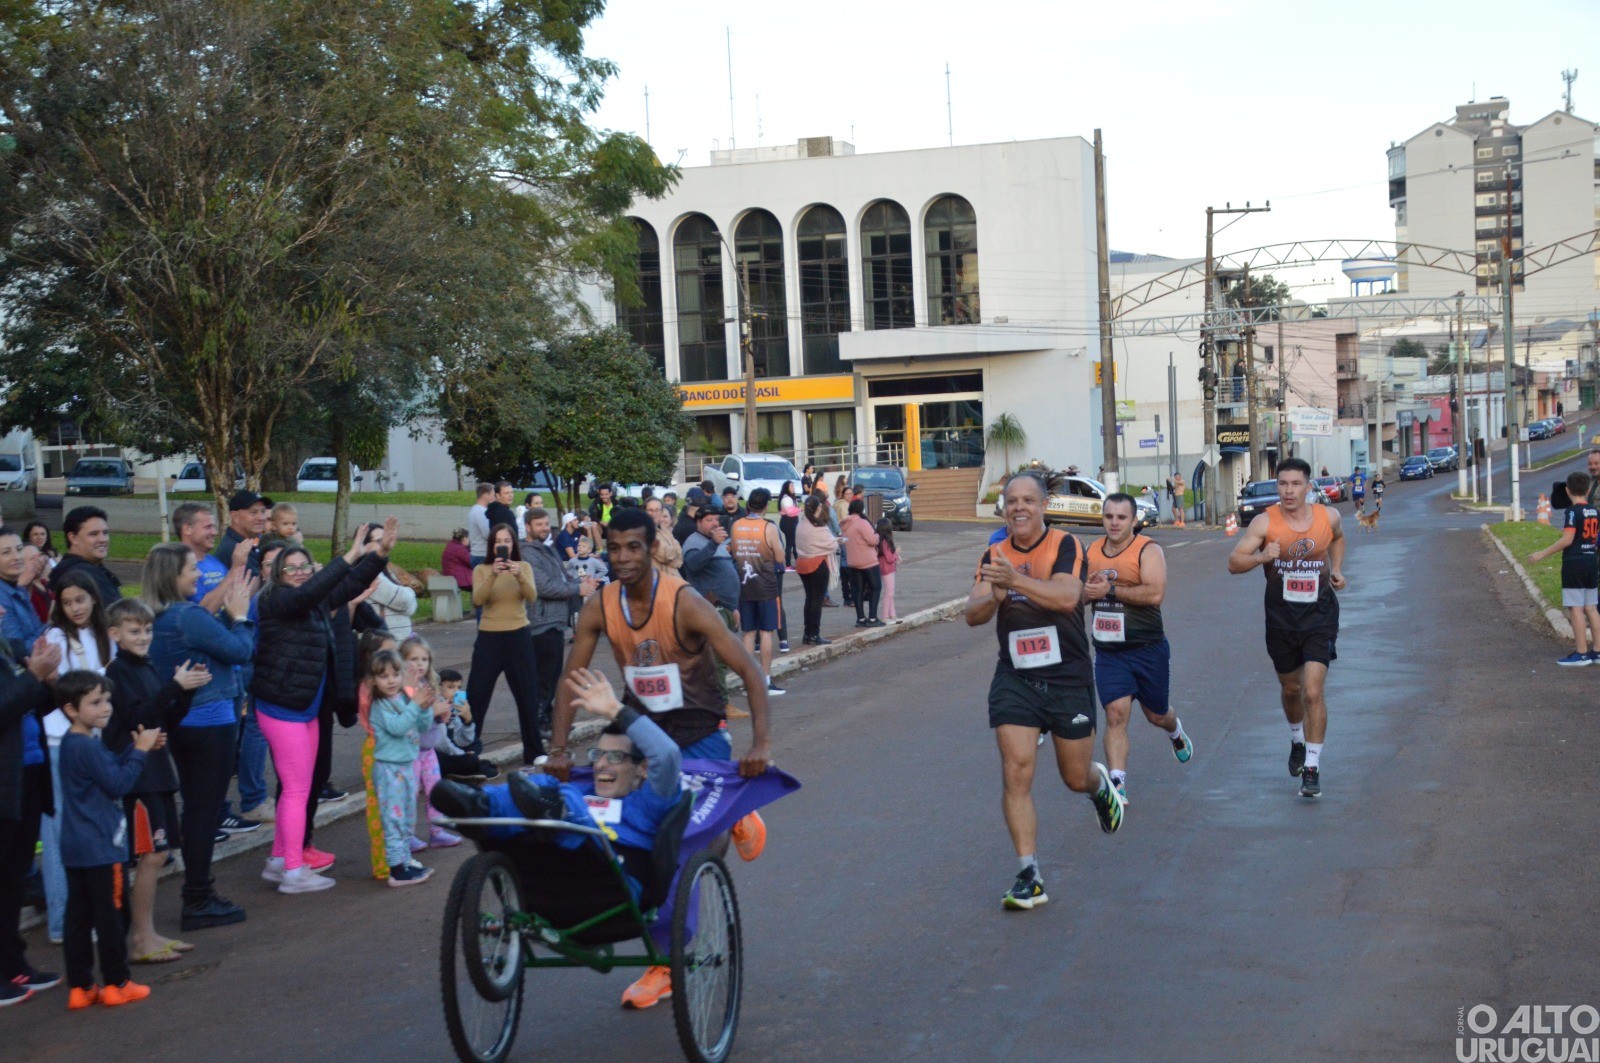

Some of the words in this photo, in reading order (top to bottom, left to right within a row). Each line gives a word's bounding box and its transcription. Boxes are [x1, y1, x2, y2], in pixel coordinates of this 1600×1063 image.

[681, 389, 720, 402] BANCO
[722, 388, 738, 399] DO
[740, 386, 781, 399] BASIL
[1290, 581, 1313, 590] 015
[1098, 620, 1119, 630] 086
[1021, 638, 1047, 652] 112
[637, 679, 667, 694] 058
